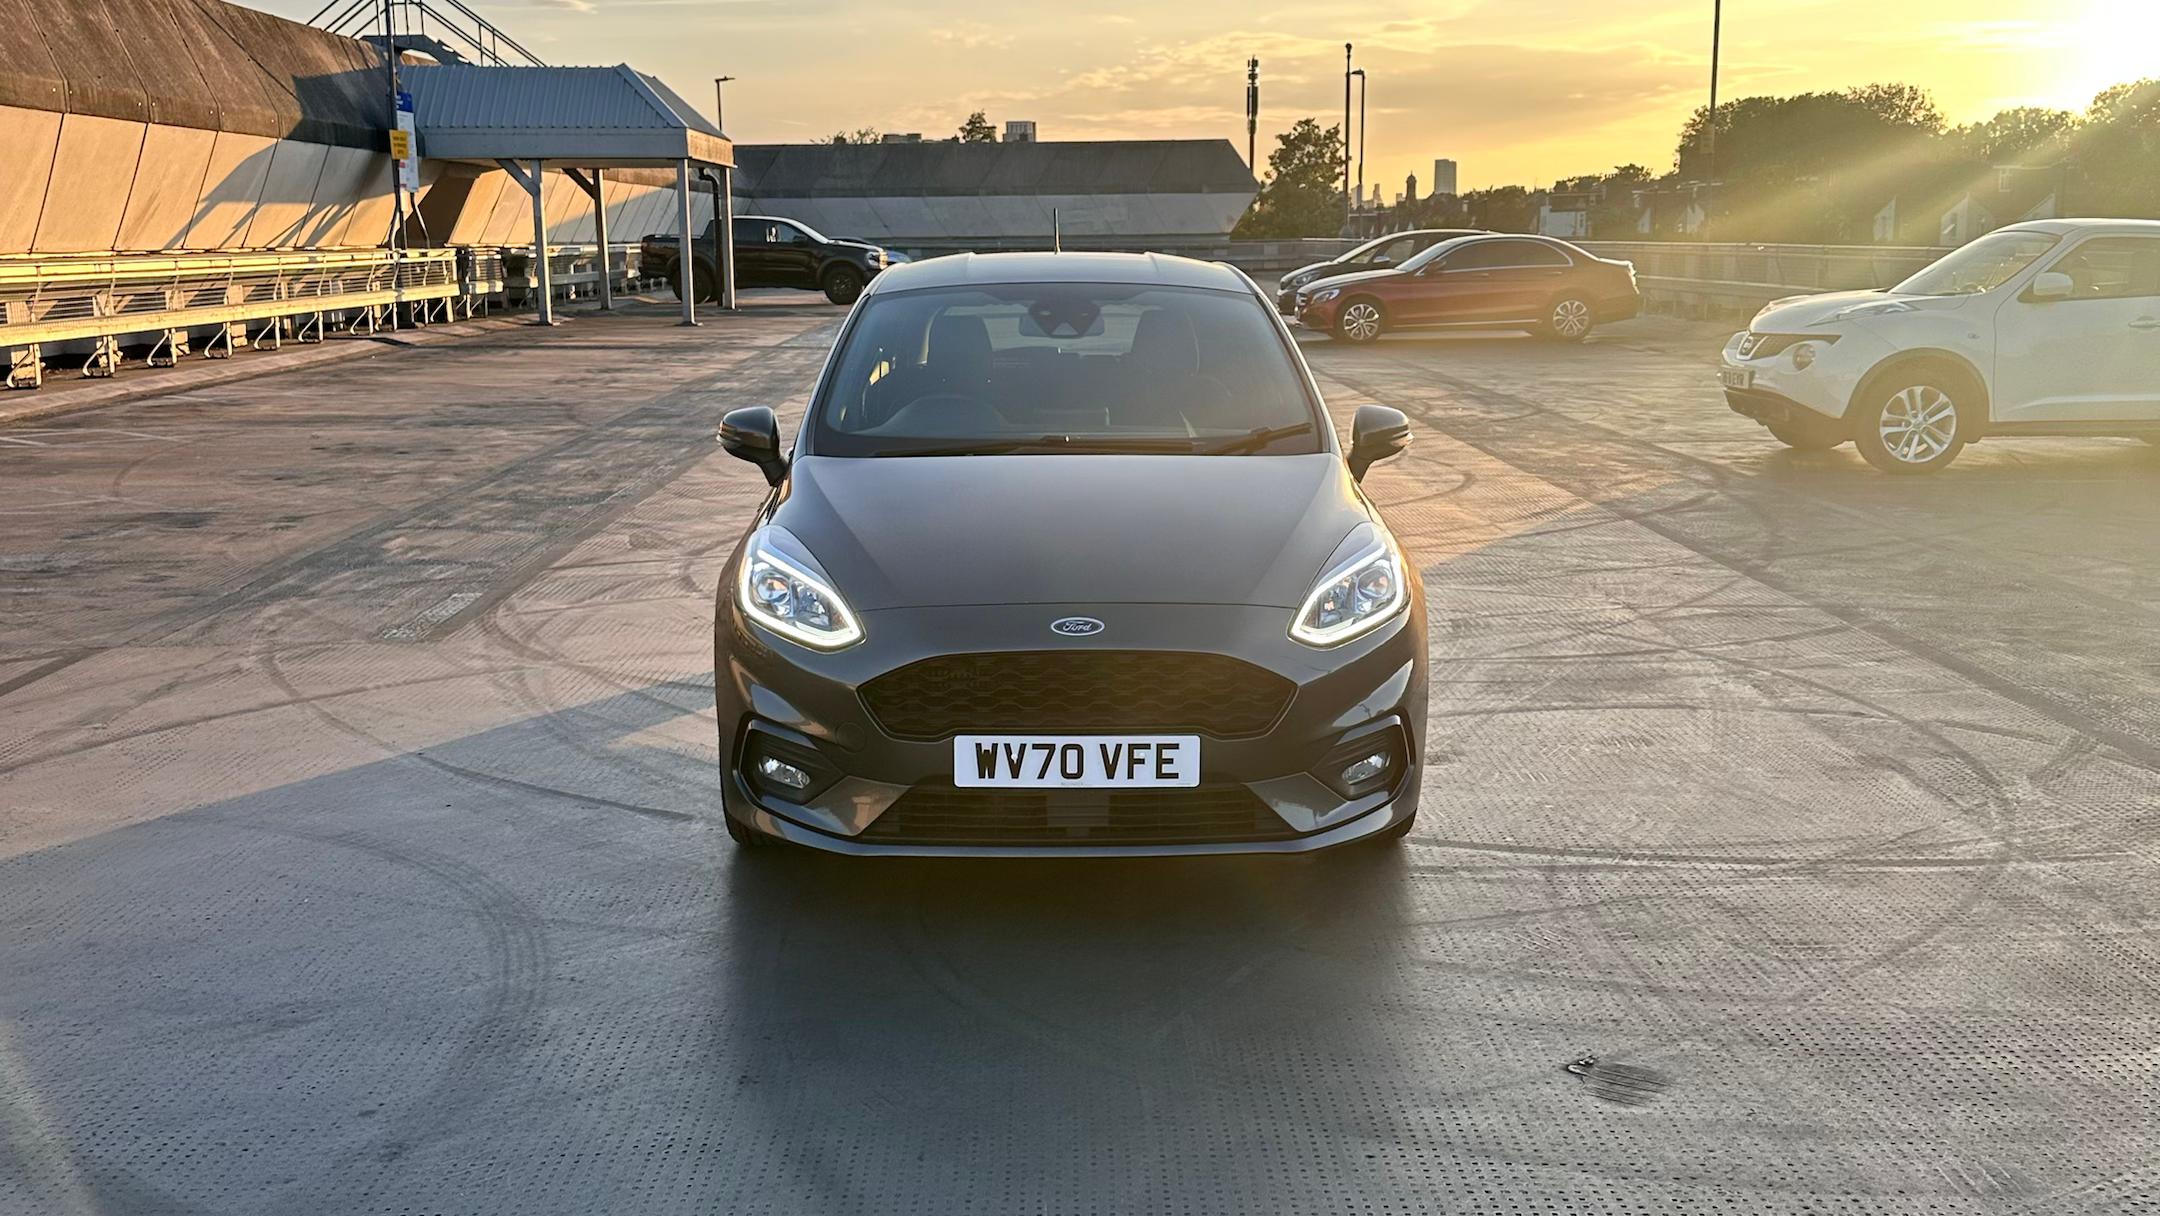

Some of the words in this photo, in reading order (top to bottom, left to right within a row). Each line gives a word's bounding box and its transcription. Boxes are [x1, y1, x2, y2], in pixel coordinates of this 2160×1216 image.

[1062, 621, 1093, 632] Ford
[974, 742, 1085, 780] WV70
[1099, 743, 1181, 780] VFE
